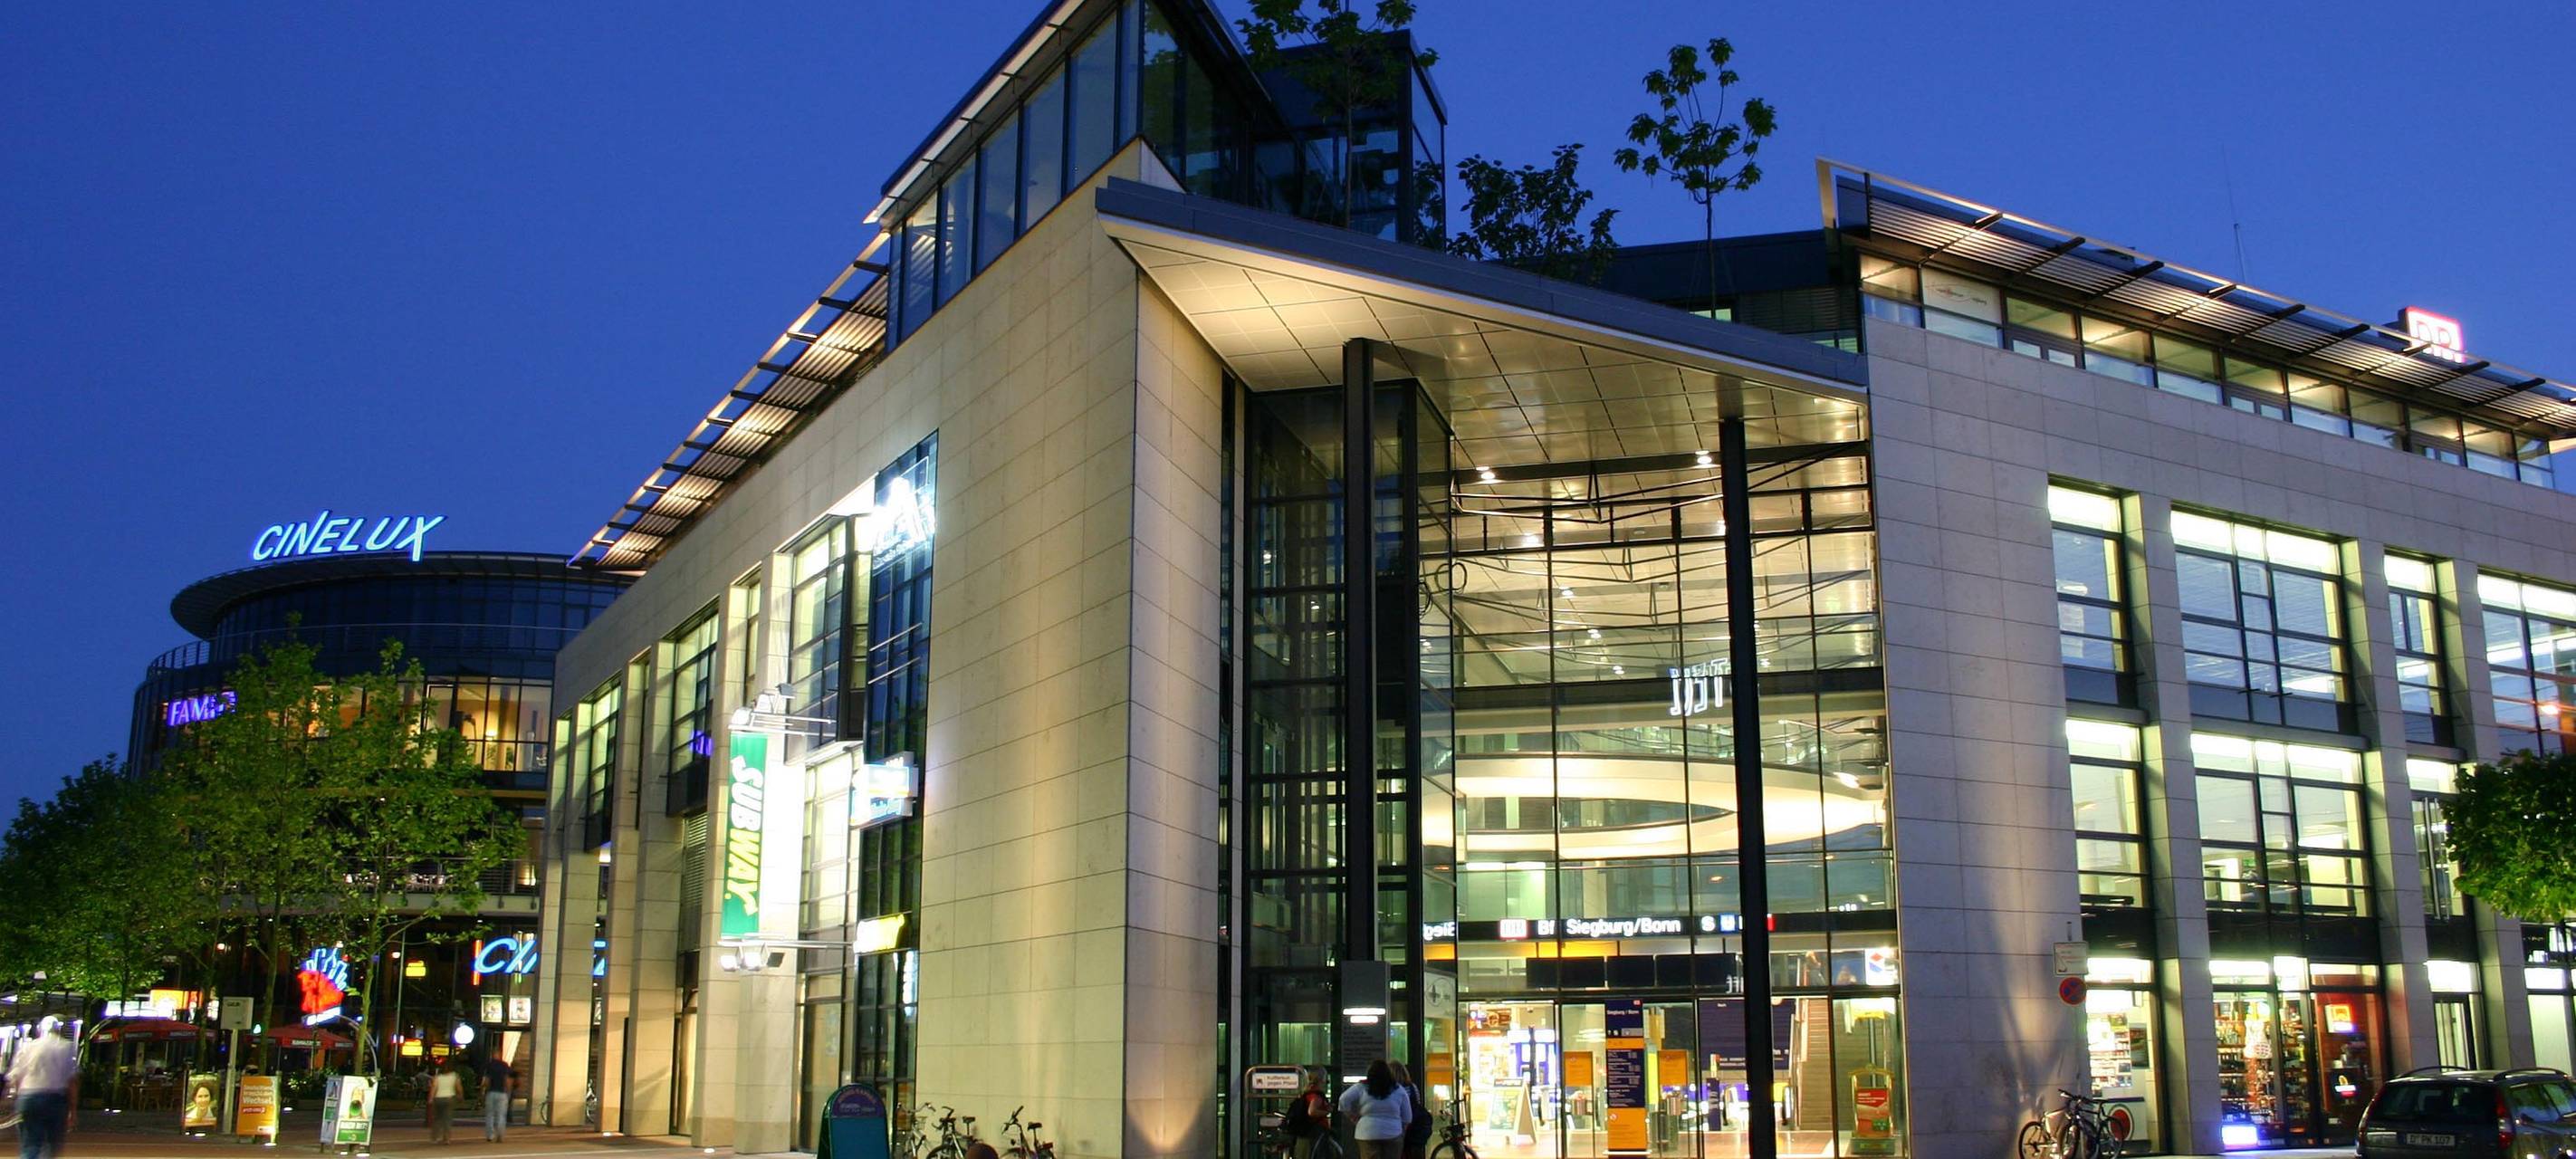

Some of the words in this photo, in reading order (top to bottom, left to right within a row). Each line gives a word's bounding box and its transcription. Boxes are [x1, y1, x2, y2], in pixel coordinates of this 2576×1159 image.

[253, 510, 444, 561] CINELUX
[727, 755, 763, 916] SUBWAY
[1566, 917, 1681, 938] Siegburg/Bonn
